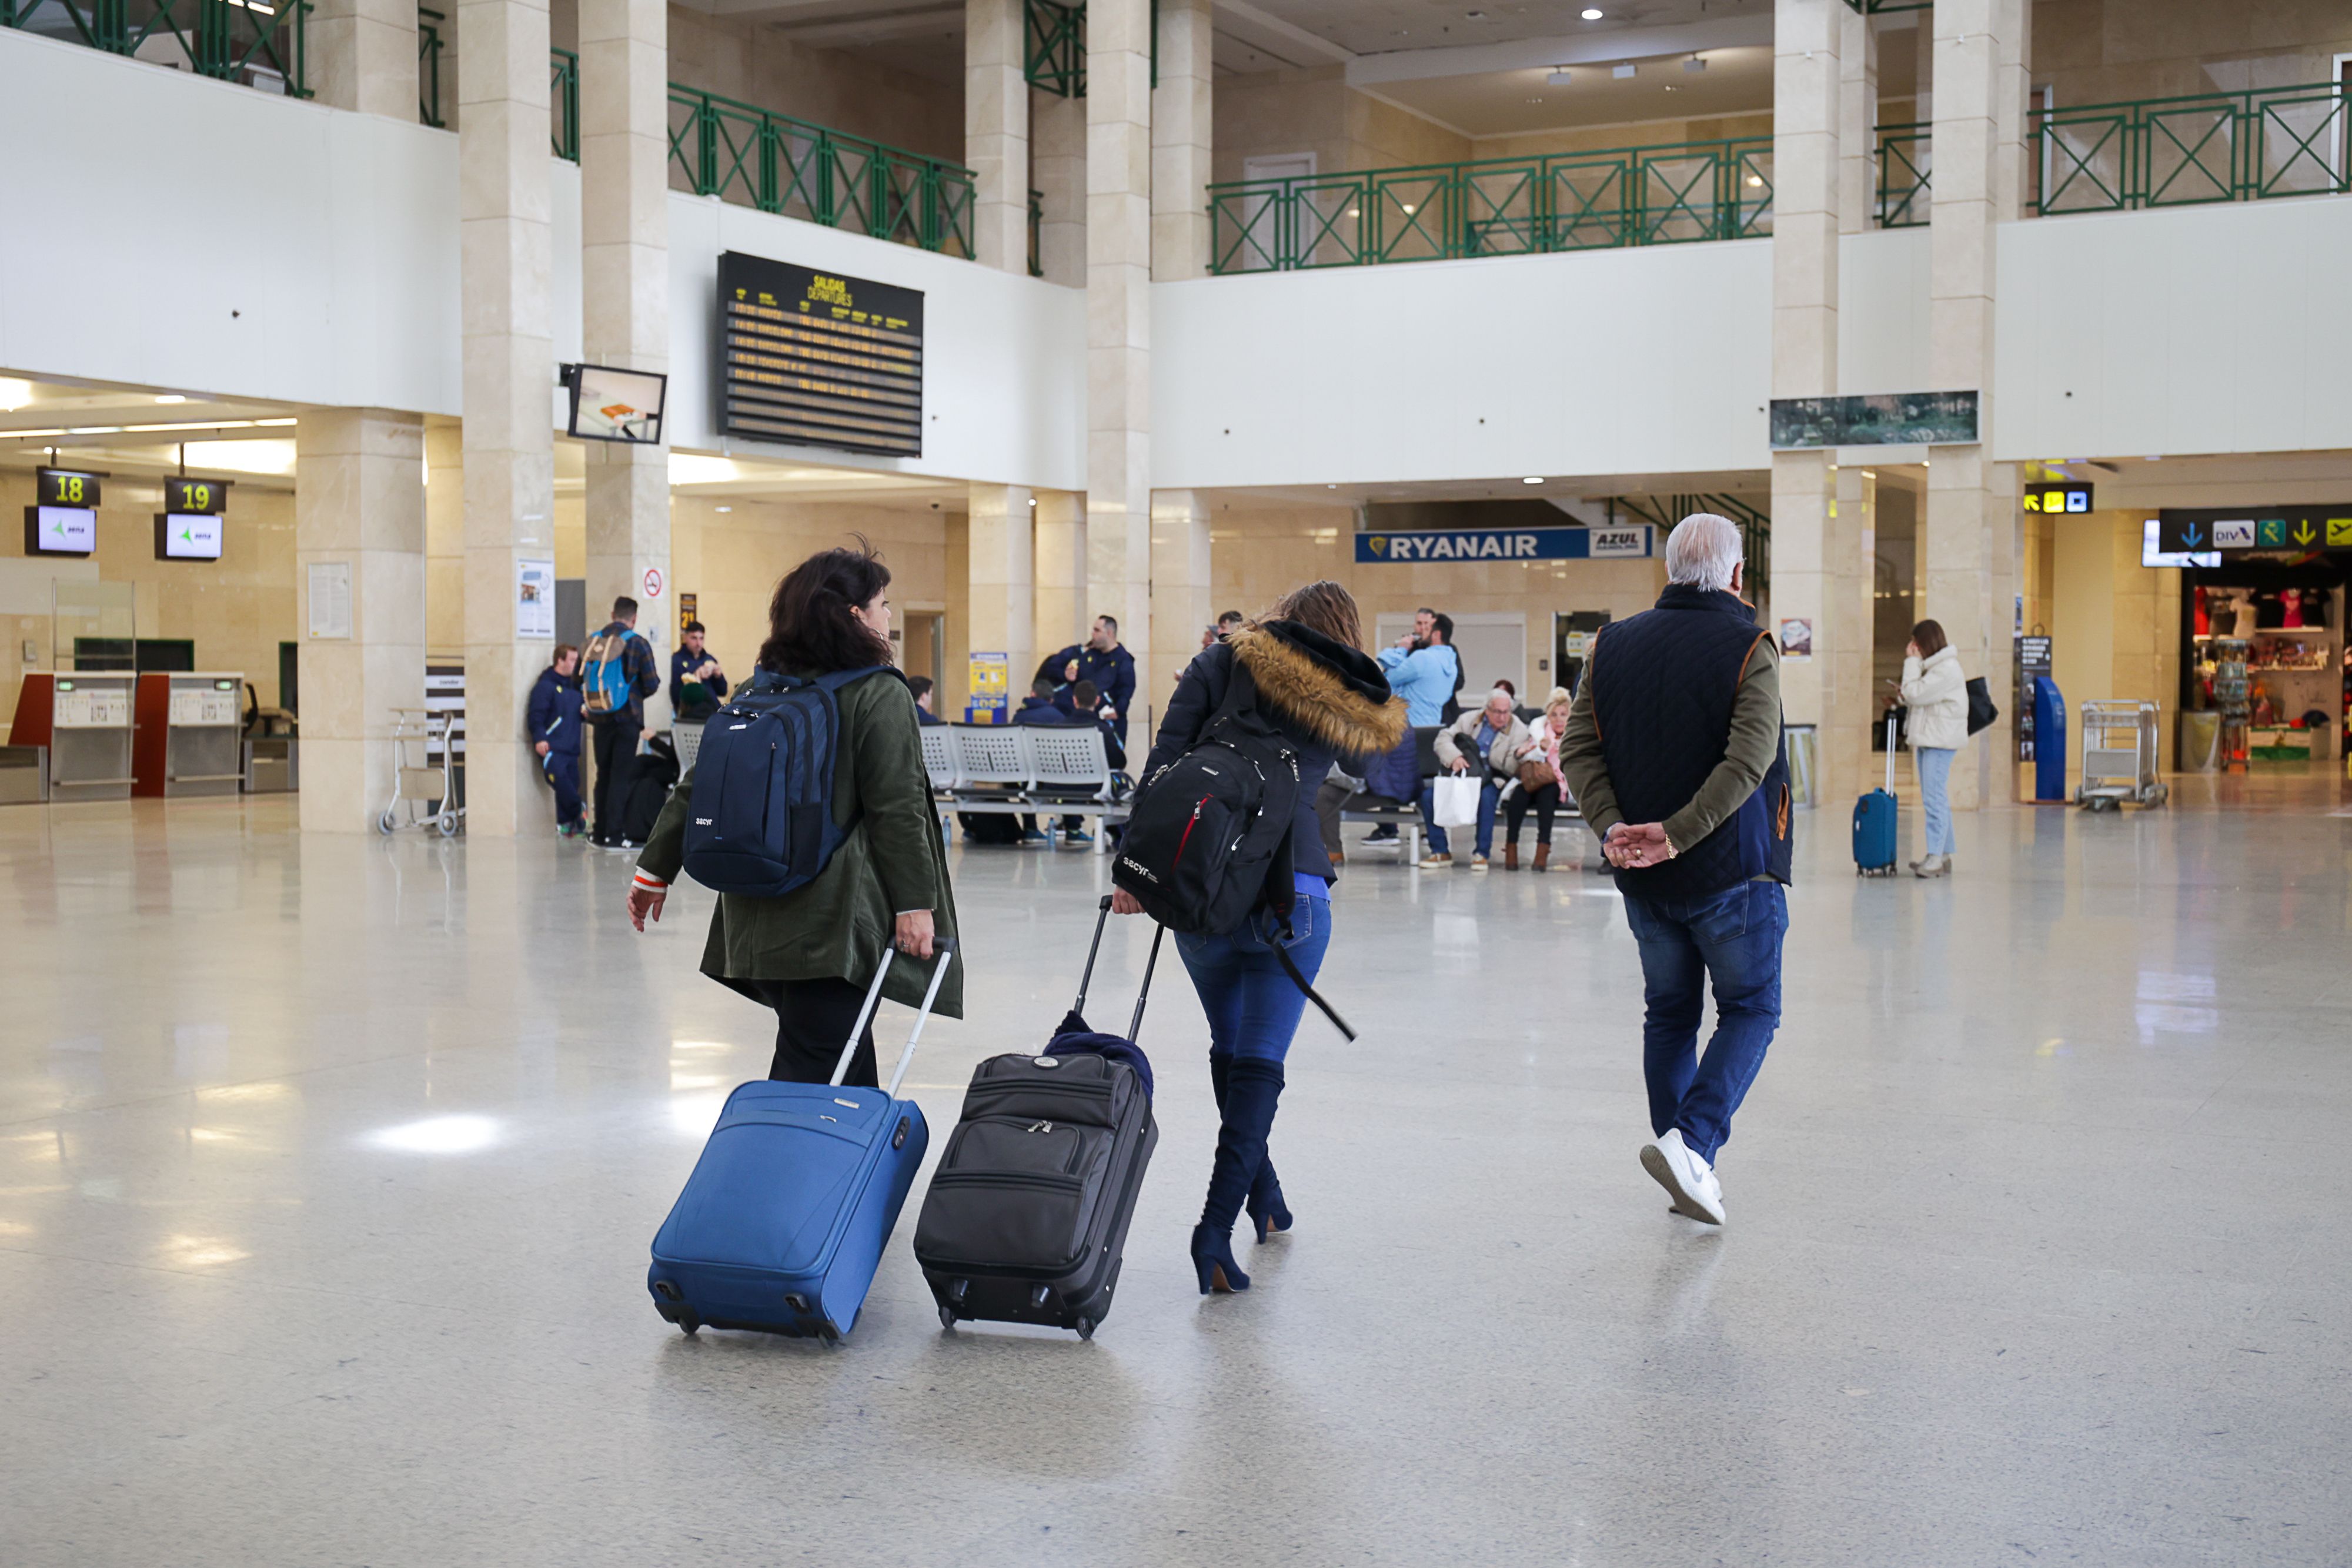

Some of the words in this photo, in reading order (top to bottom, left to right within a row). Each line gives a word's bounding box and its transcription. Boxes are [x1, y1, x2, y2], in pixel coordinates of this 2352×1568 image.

[813, 275, 846, 293] SALIDAS
[807, 285, 853, 307] DEPARTURES
[56, 476, 83, 503] 18
[182, 484, 209, 510] 19
[1390, 534, 1538, 559] RYANAIR
[1597, 533, 1638, 544] AZUL
[696, 818, 713, 826] sacyr
[1123, 857, 1149, 876] sacyr
